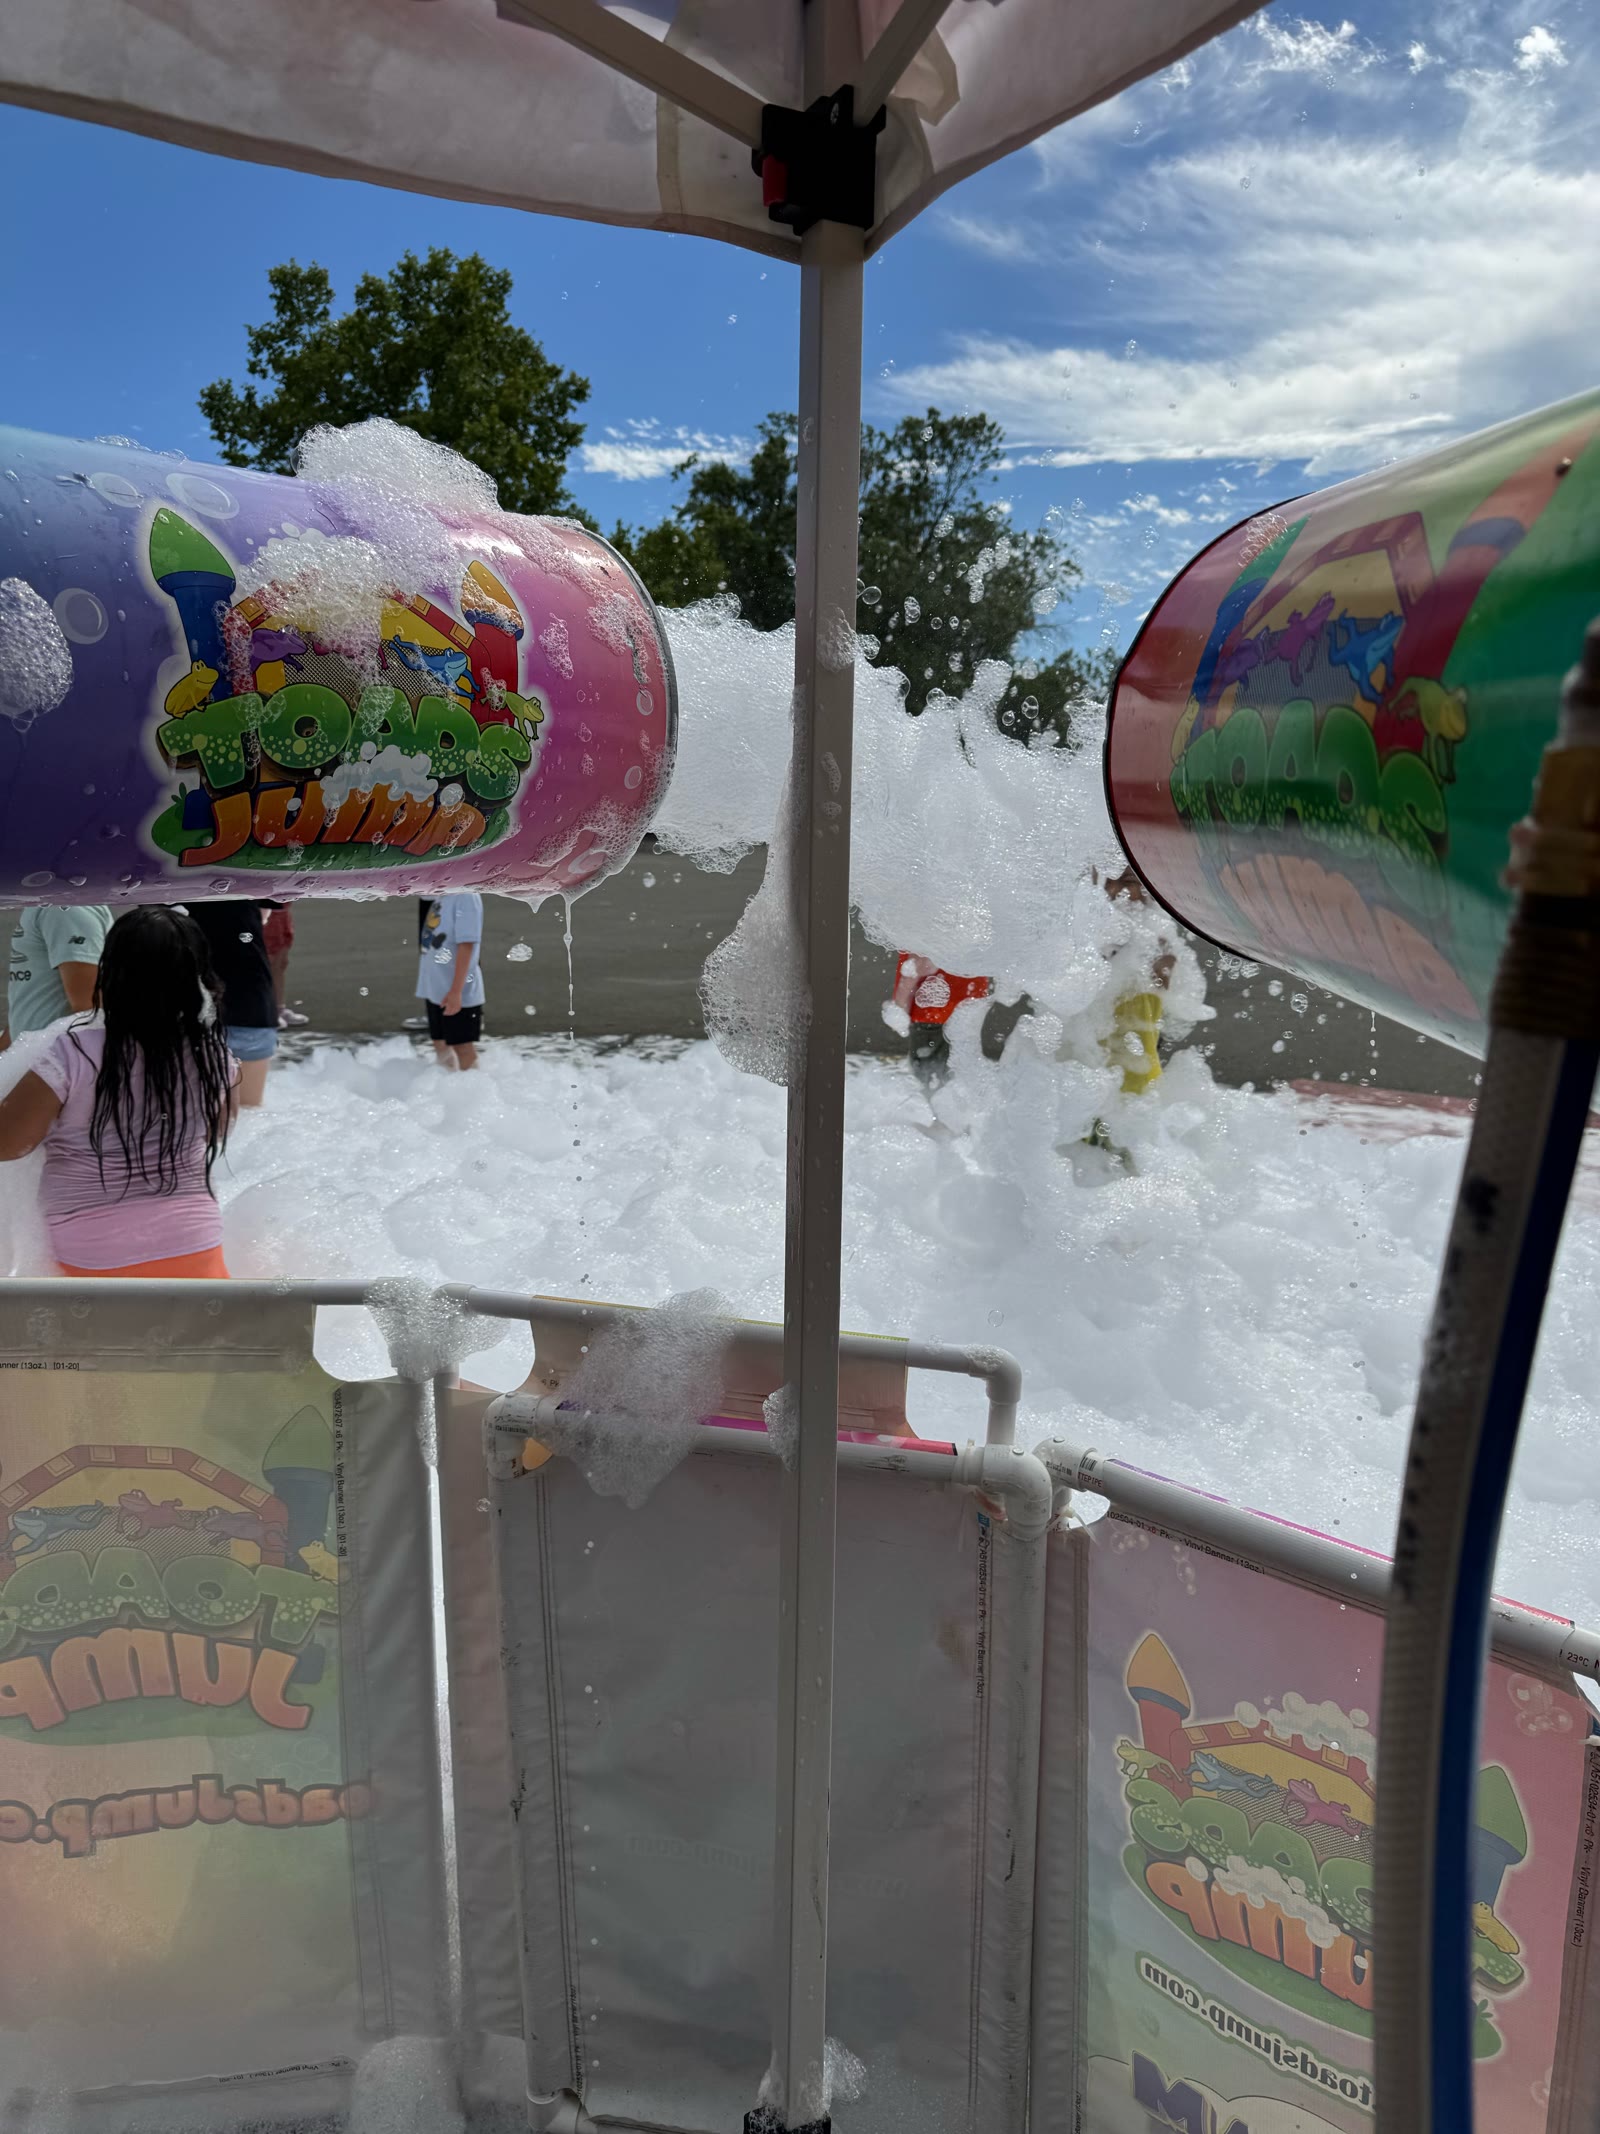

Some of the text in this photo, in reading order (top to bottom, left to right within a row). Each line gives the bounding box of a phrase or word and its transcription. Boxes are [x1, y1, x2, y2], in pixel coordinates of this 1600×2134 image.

[157, 683, 532, 800] TOADS
[1169, 698, 1447, 918] TOADS
[20, 1361, 48, 1370] (13oz.)
[53, 1361, 80, 1371] [01-20]
[335, 1462, 345, 1479] Vinyl
[336, 1480, 345, 1504] Banner
[976, 1631, 987, 1648] Vinyl
[976, 1649, 987, 1675] Banner
[1577, 1866, 1591, 1888] Vinyl
[1576, 1887, 1590, 1918] Banner
